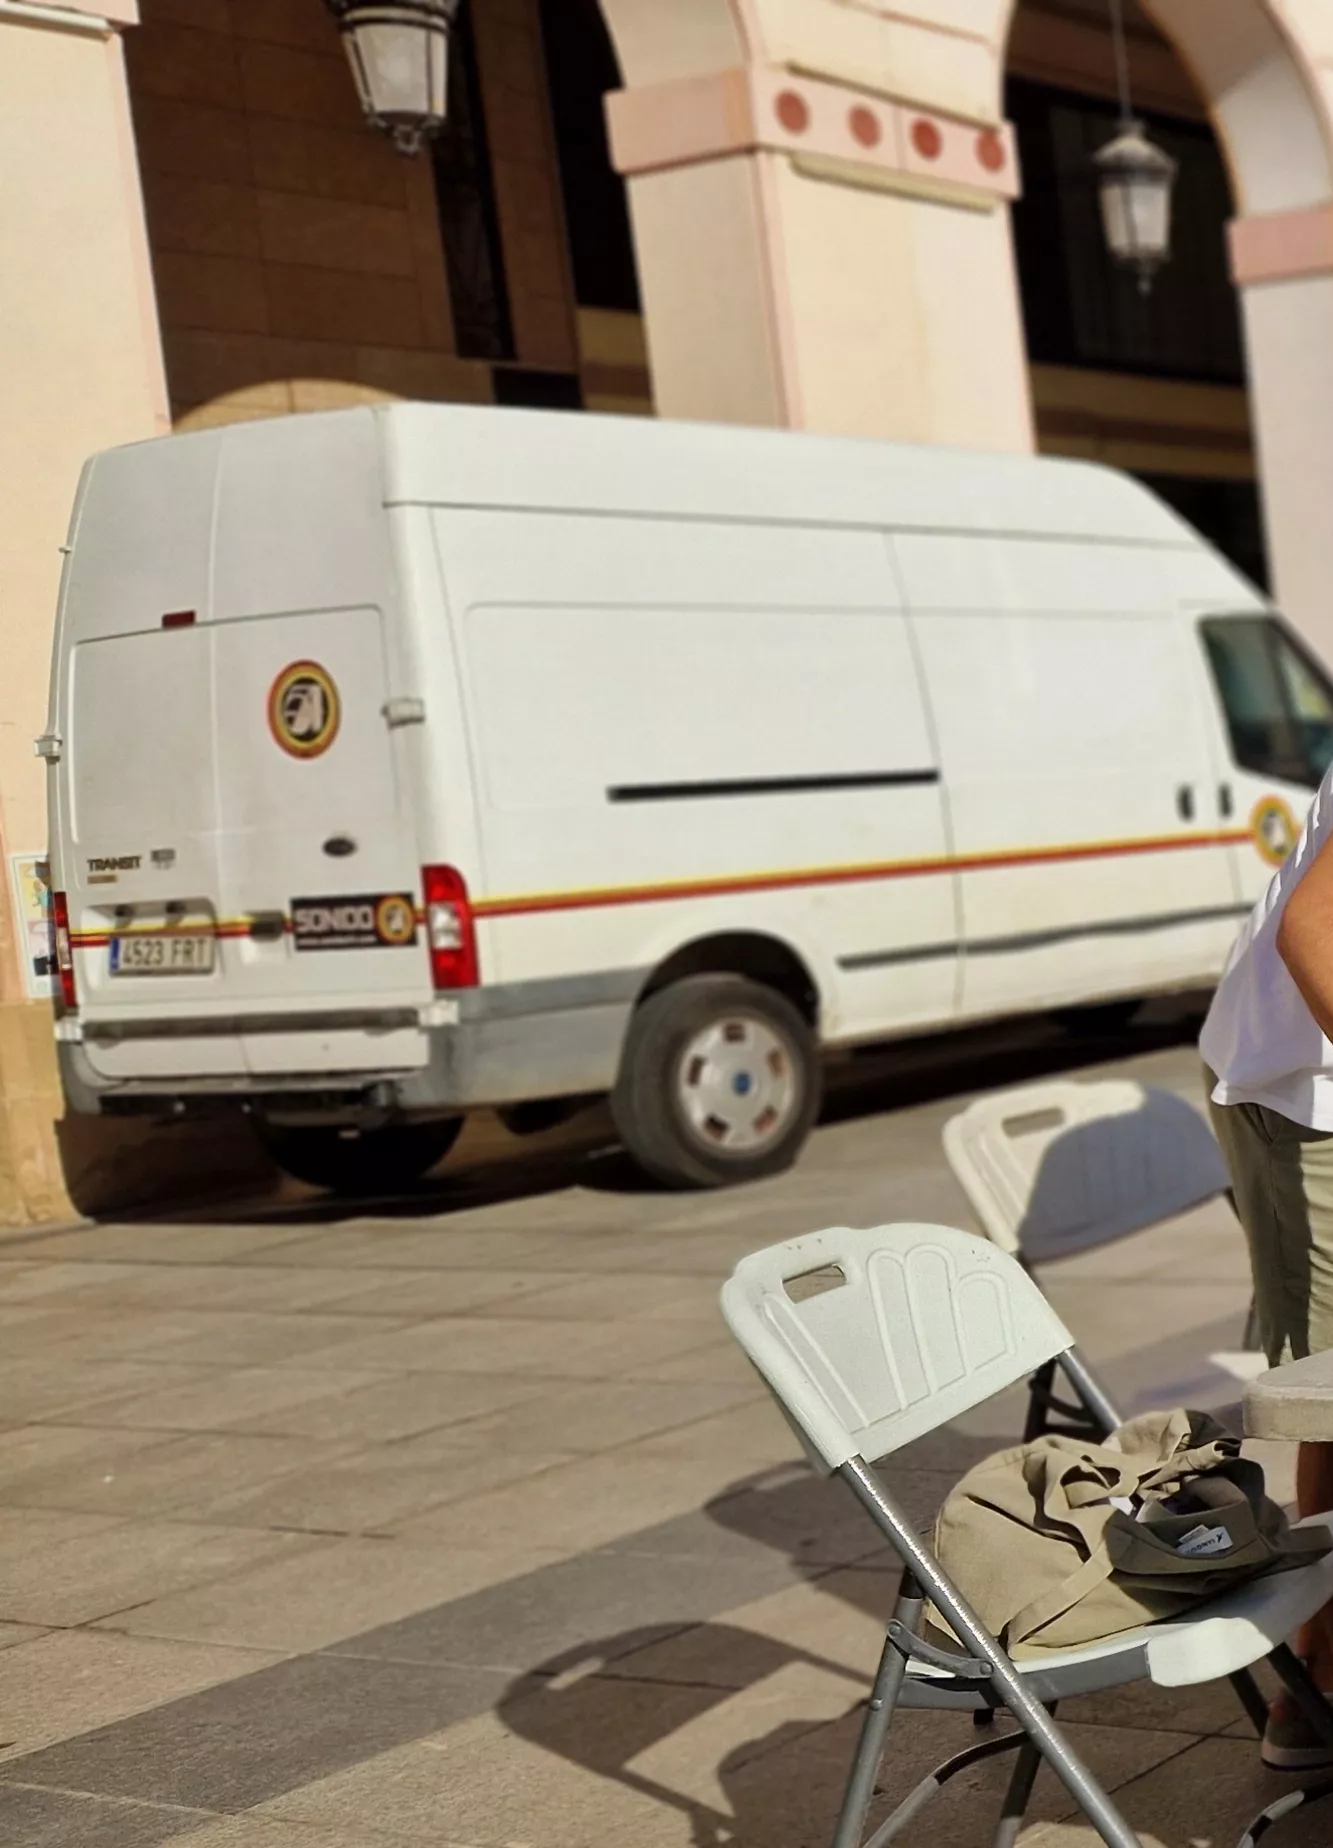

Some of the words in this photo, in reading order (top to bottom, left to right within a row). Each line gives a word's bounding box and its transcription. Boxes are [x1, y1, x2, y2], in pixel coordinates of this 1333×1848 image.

[86, 855, 141, 871] TRANSIT
[295, 905, 374, 934] SONIDO
[122, 939, 164, 966] 4523
[169, 938, 205, 965] FRT
